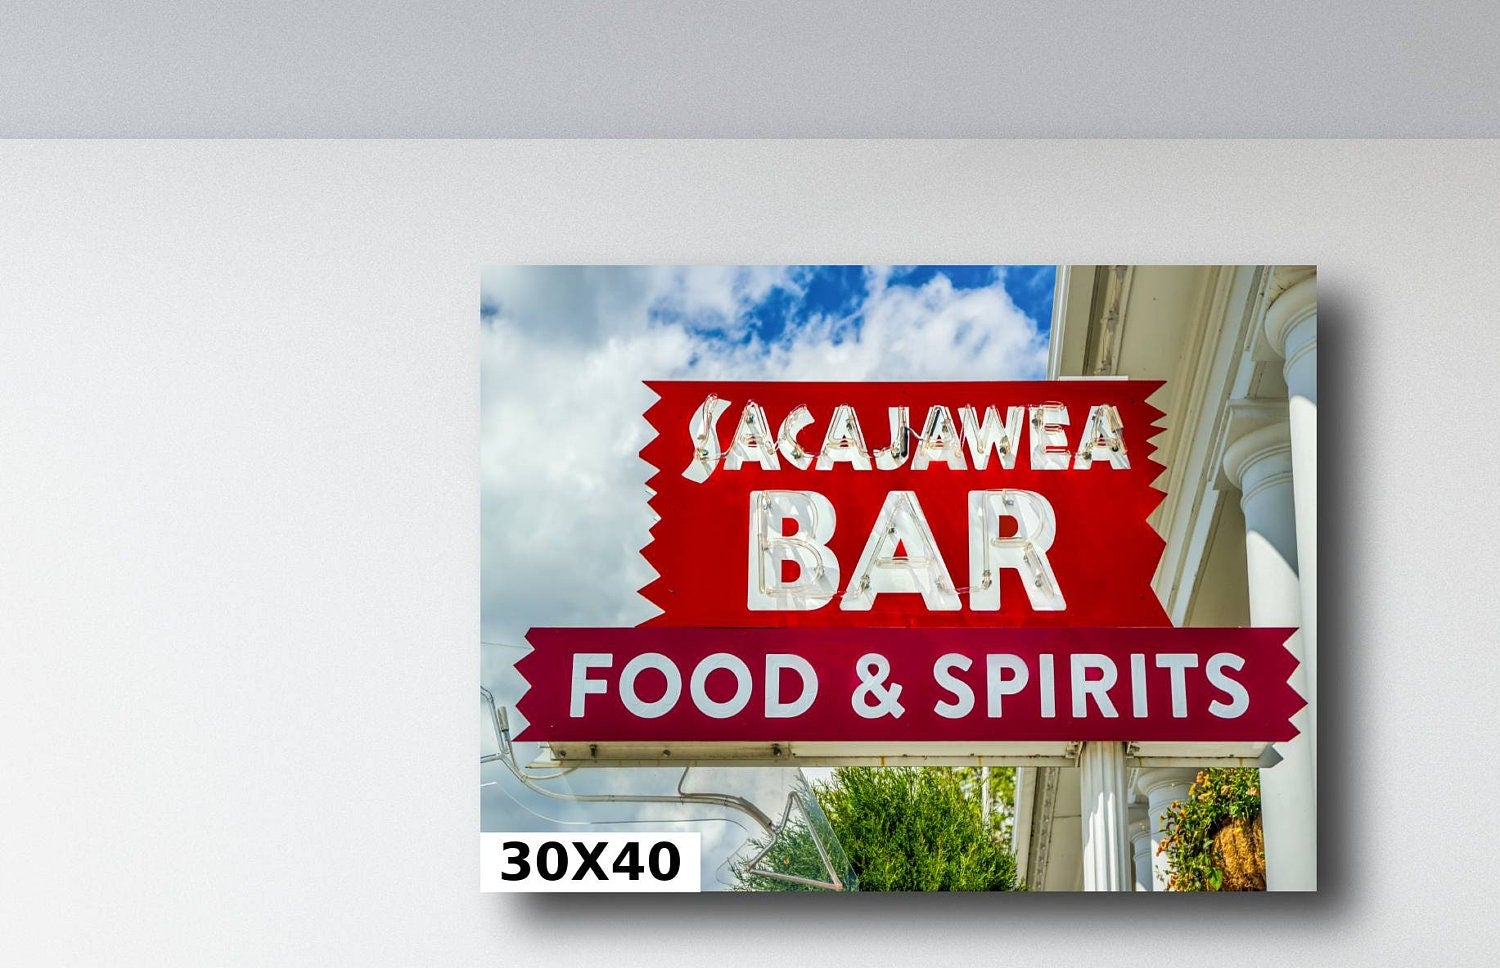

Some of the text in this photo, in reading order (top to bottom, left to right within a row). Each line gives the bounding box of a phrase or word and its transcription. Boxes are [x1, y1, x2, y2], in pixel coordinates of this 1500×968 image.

[682, 394, 1131, 483] SACAJAWEA
[747, 489, 1066, 611] BAR
[570, 653, 1249, 718] FOOD & SPIRITS
